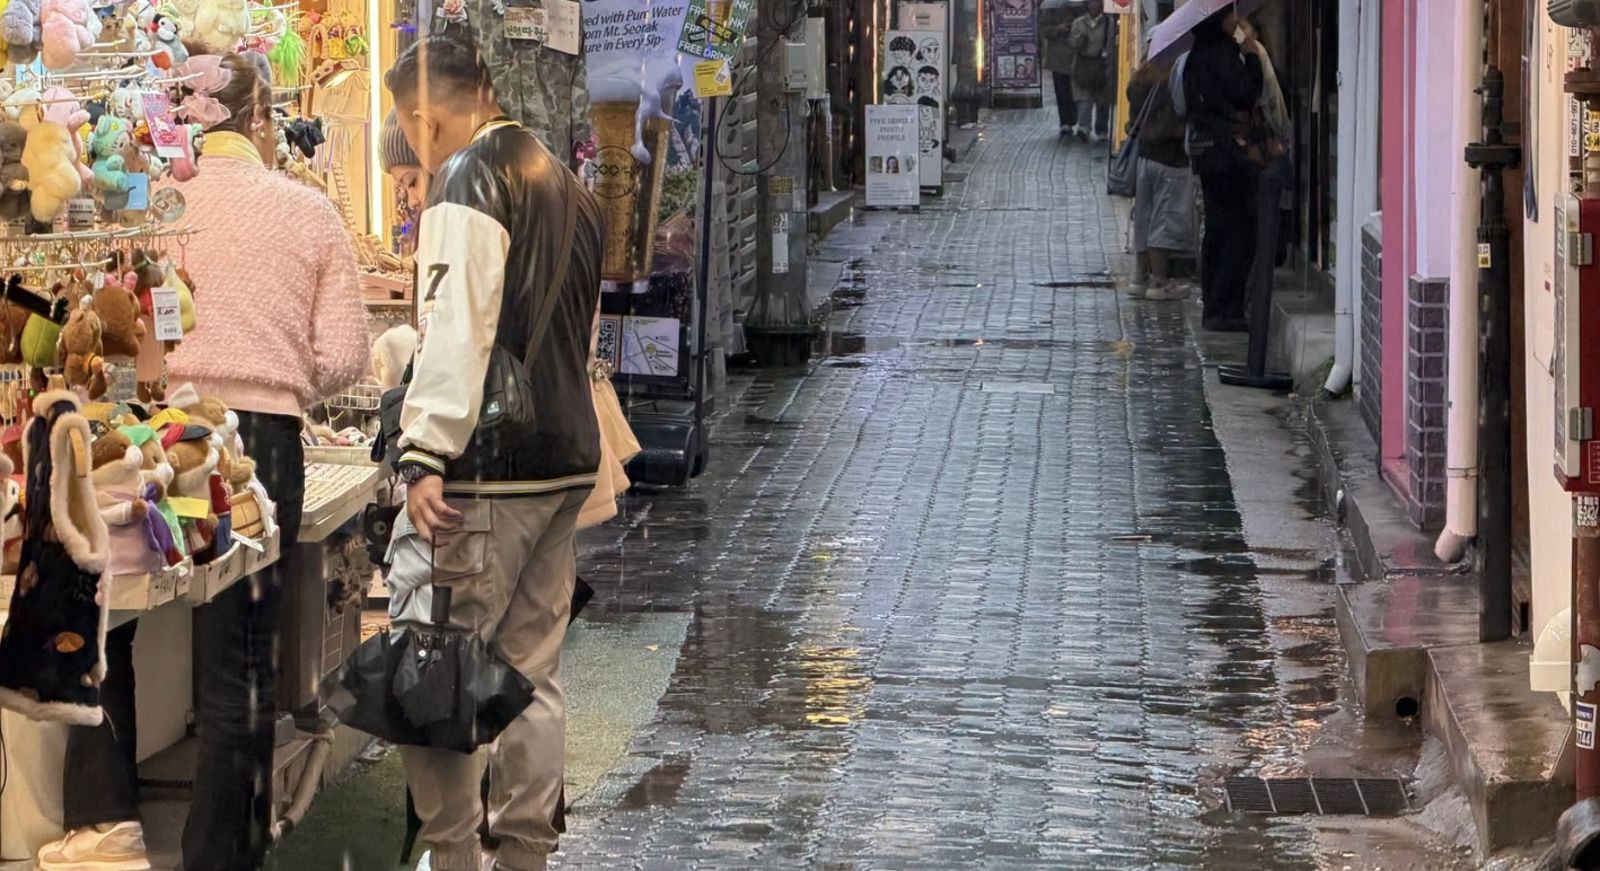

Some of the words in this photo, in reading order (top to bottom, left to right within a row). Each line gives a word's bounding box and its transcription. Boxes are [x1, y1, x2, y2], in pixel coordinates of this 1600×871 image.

[601, 11, 624, 24] with
[626, 10, 650, 22] Pure
[652, 6, 684, 18] Water
[603, 26, 621, 38] Mt.
[622, 20, 659, 36] Seorak
[584, 42, 602, 53] ure
[604, 39, 614, 51] in
[615, 37, 645, 50] Every
[678, 41, 703, 55] FREE
[703, 48, 734, 63] DRINK
[424, 263, 450, 302] 7
